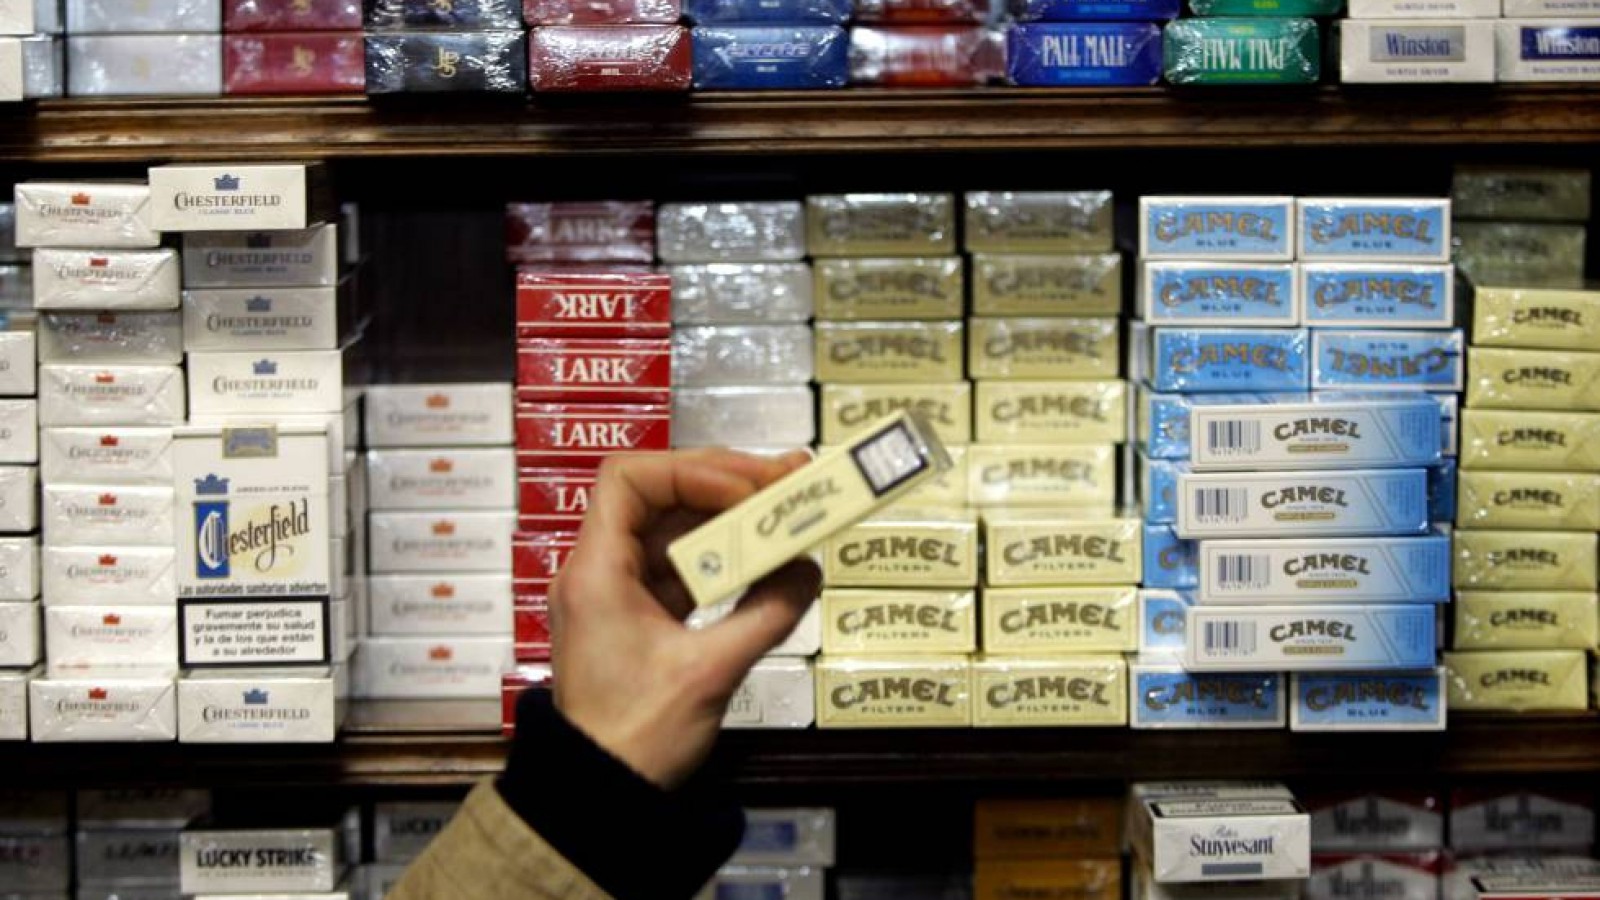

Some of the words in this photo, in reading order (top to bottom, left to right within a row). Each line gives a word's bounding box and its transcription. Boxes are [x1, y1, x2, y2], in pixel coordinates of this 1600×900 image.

[1042, 35, 1082, 67] PALL
[1086, 35, 1127, 67] MALL
[1386, 32, 1451, 57] Winston
[174, 192, 282, 211] CHESTERFIELD
[1155, 211, 1279, 242] CAMEL
[1311, 212, 1434, 244] CAMEL
[206, 250, 313, 268] CHESTERFIELD
[1161, 276, 1282, 307] CAMEL
[1315, 278, 1437, 310] CAMEL
[553, 293, 636, 318] LARK
[1512, 306, 1582, 326] CAMEL
[207, 314, 313, 331] CHESTERFIELD
[552, 358, 637, 384] LARK
[1171, 343, 1293, 374] CAMEL
[1328, 346, 1450, 378] CAMEL
[212, 376, 319, 394] CHESTERFIELD
[1503, 365, 1573, 385] CAMEL
[991, 394, 1108, 424] CAMEL
[550, 422, 635, 448] LARK
[1274, 417, 1361, 441] CAMEL
[1497, 428, 1568, 447] CAMEL
[981, 457, 1098, 487] CAMEL
[755, 475, 843, 538] CAMEL
[1261, 485, 1349, 509] CAMEL
[1493, 487, 1563, 507] CAMEL
[199, 497, 310, 571] Chesterfield
[839, 536, 961, 567] CAMEL
[1003, 534, 1126, 566] CAMEL
[1490, 548, 1560, 567] CAMEL
[1283, 553, 1371, 576] CAMEL
[193, 622, 262, 633] gravemente
[265, 622, 280, 631] su
[284, 620, 315, 630] salud
[206, 609, 243, 619] Fumar
[246, 608, 302, 620] perjudica
[837, 604, 959, 636] CAMEL
[1000, 602, 1120, 634] CAMEL
[1490, 608, 1558, 627] CAMEL
[203, 634, 215, 643] la
[217, 634, 232, 643] de
[235, 634, 253, 643] los
[256, 635, 278, 645] que
[281, 633, 314, 642] están
[1269, 619, 1357, 642] CAMEL
[223, 647, 237, 656] su
[240, 645, 296, 656] alrededor
[1480, 668, 1552, 687] CAMEL
[831, 677, 955, 710] CAMEL
[986, 676, 1111, 709] CAMEL
[1145, 679, 1270, 711] CAMEL
[1305, 681, 1430, 712] CAMEL
[202, 706, 310, 723] CHESTERFIELD
[196, 849, 250, 868] LUCKY
[1189, 834, 1275, 861] Stuyvesant
